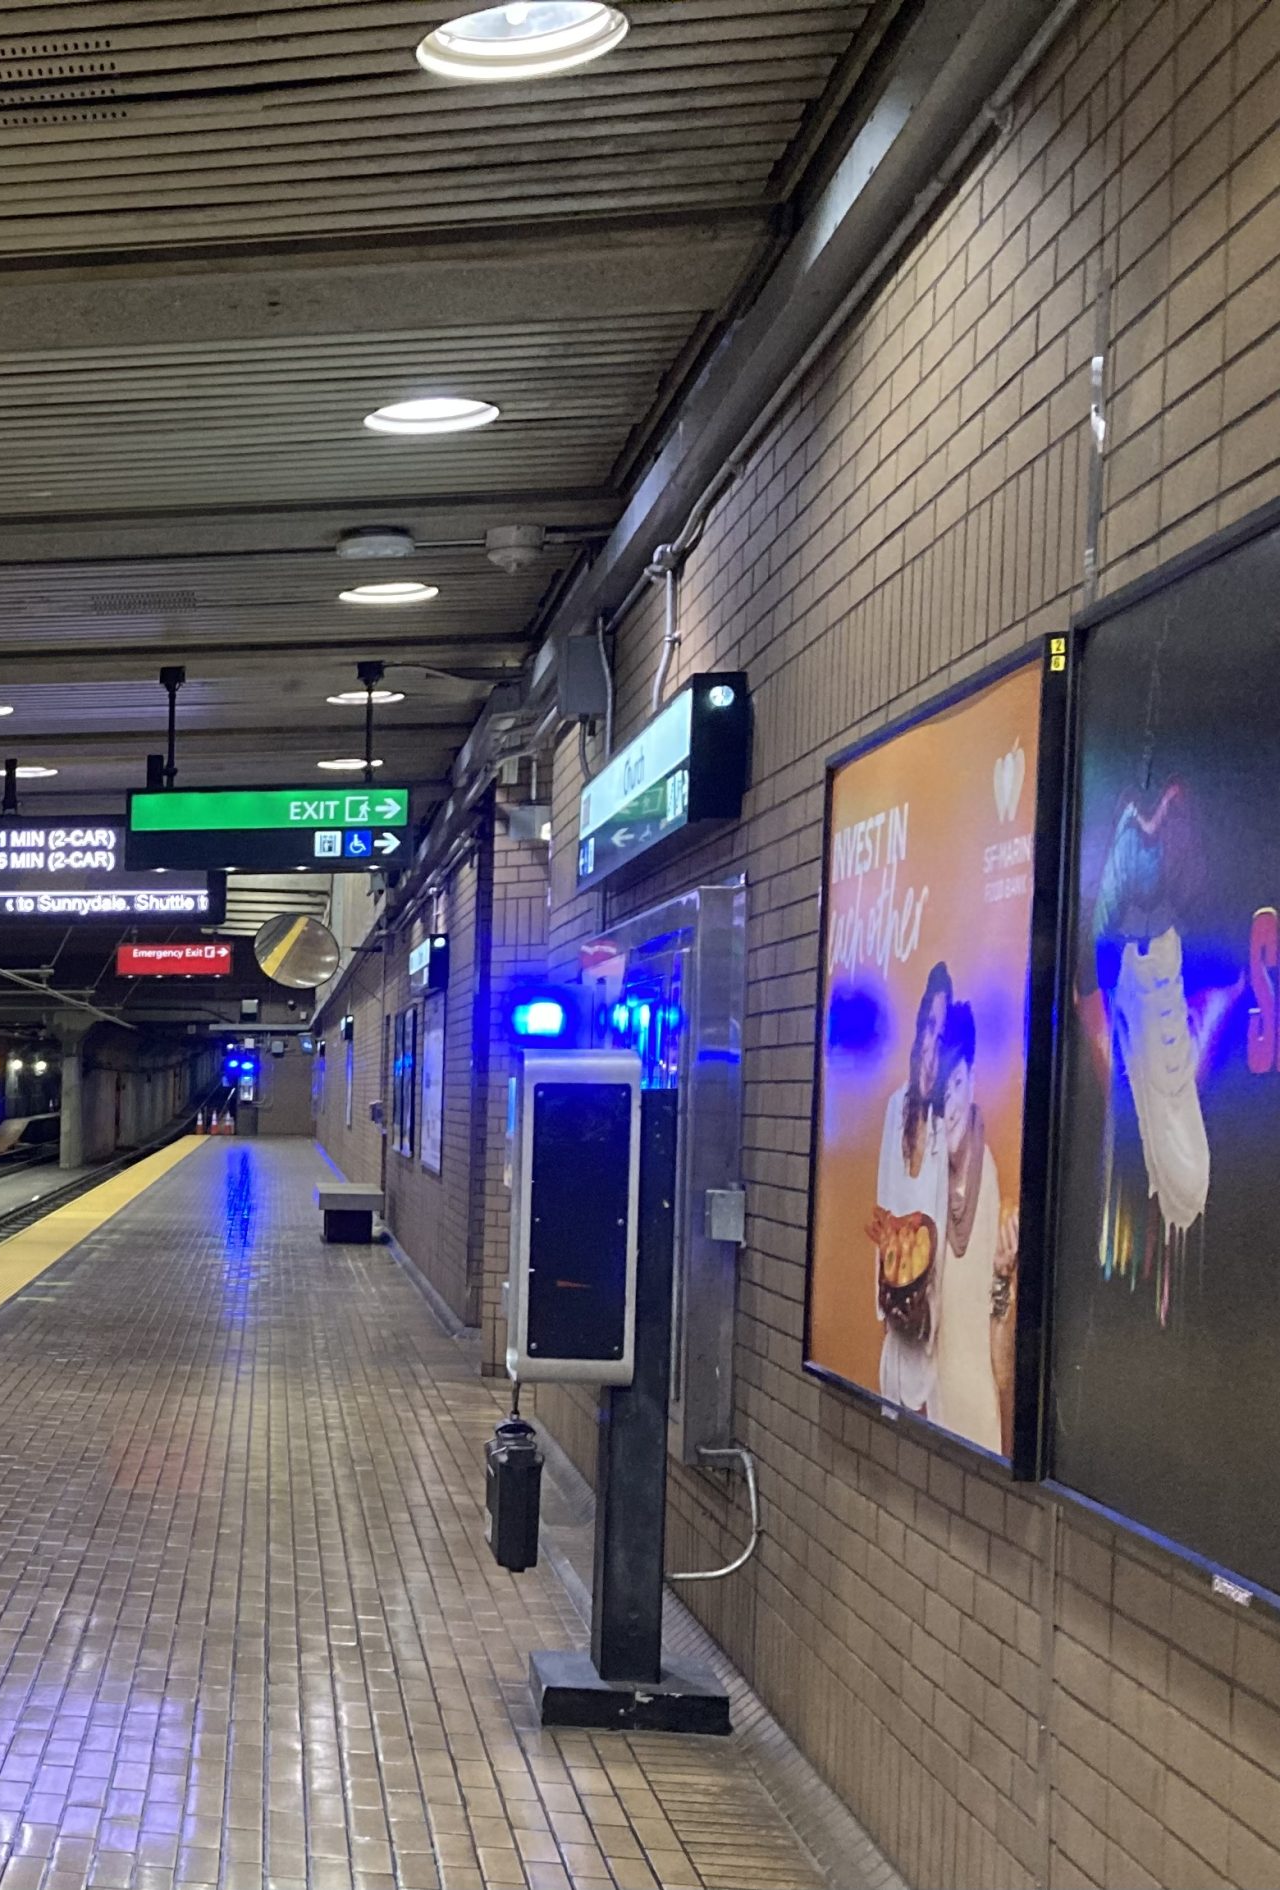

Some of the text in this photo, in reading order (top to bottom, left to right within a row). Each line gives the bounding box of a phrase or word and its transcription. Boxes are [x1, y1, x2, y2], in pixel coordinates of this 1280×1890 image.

[288, 800, 340, 820] EXIT
[10, 830, 45, 848] MIN
[48, 830, 116, 850] (2-CAR)
[831, 801, 909, 884] INVEST IN
[10, 851, 45, 869] MIN
[48, 851, 116, 872] (2-CAR)
[16, 895, 34, 912] to
[134, 894, 195, 912] Shuttle
[866, 855, 929, 981] other
[132, 947, 203, 960] Emergency Exit
